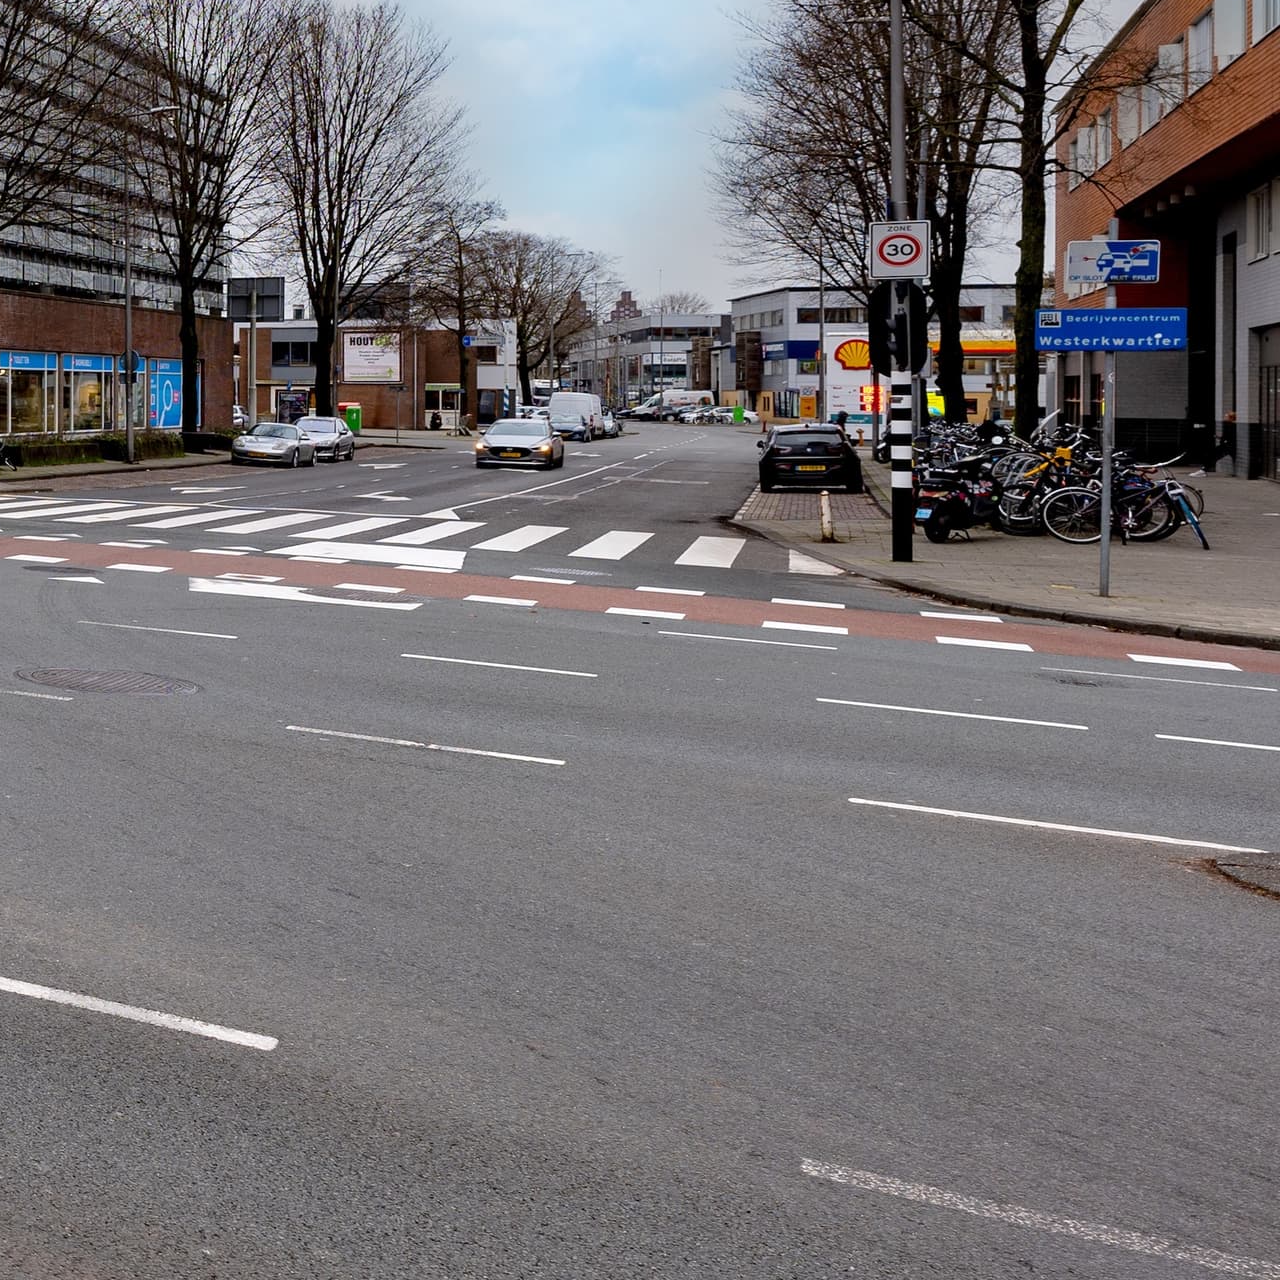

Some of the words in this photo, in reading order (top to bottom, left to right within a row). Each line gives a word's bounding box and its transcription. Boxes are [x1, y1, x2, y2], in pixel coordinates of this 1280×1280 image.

[886, 243, 914, 257] 30
[1066, 314, 1181, 324] Bedrijvencentrum
[1039, 334, 1181, 346] Westerkwartier
